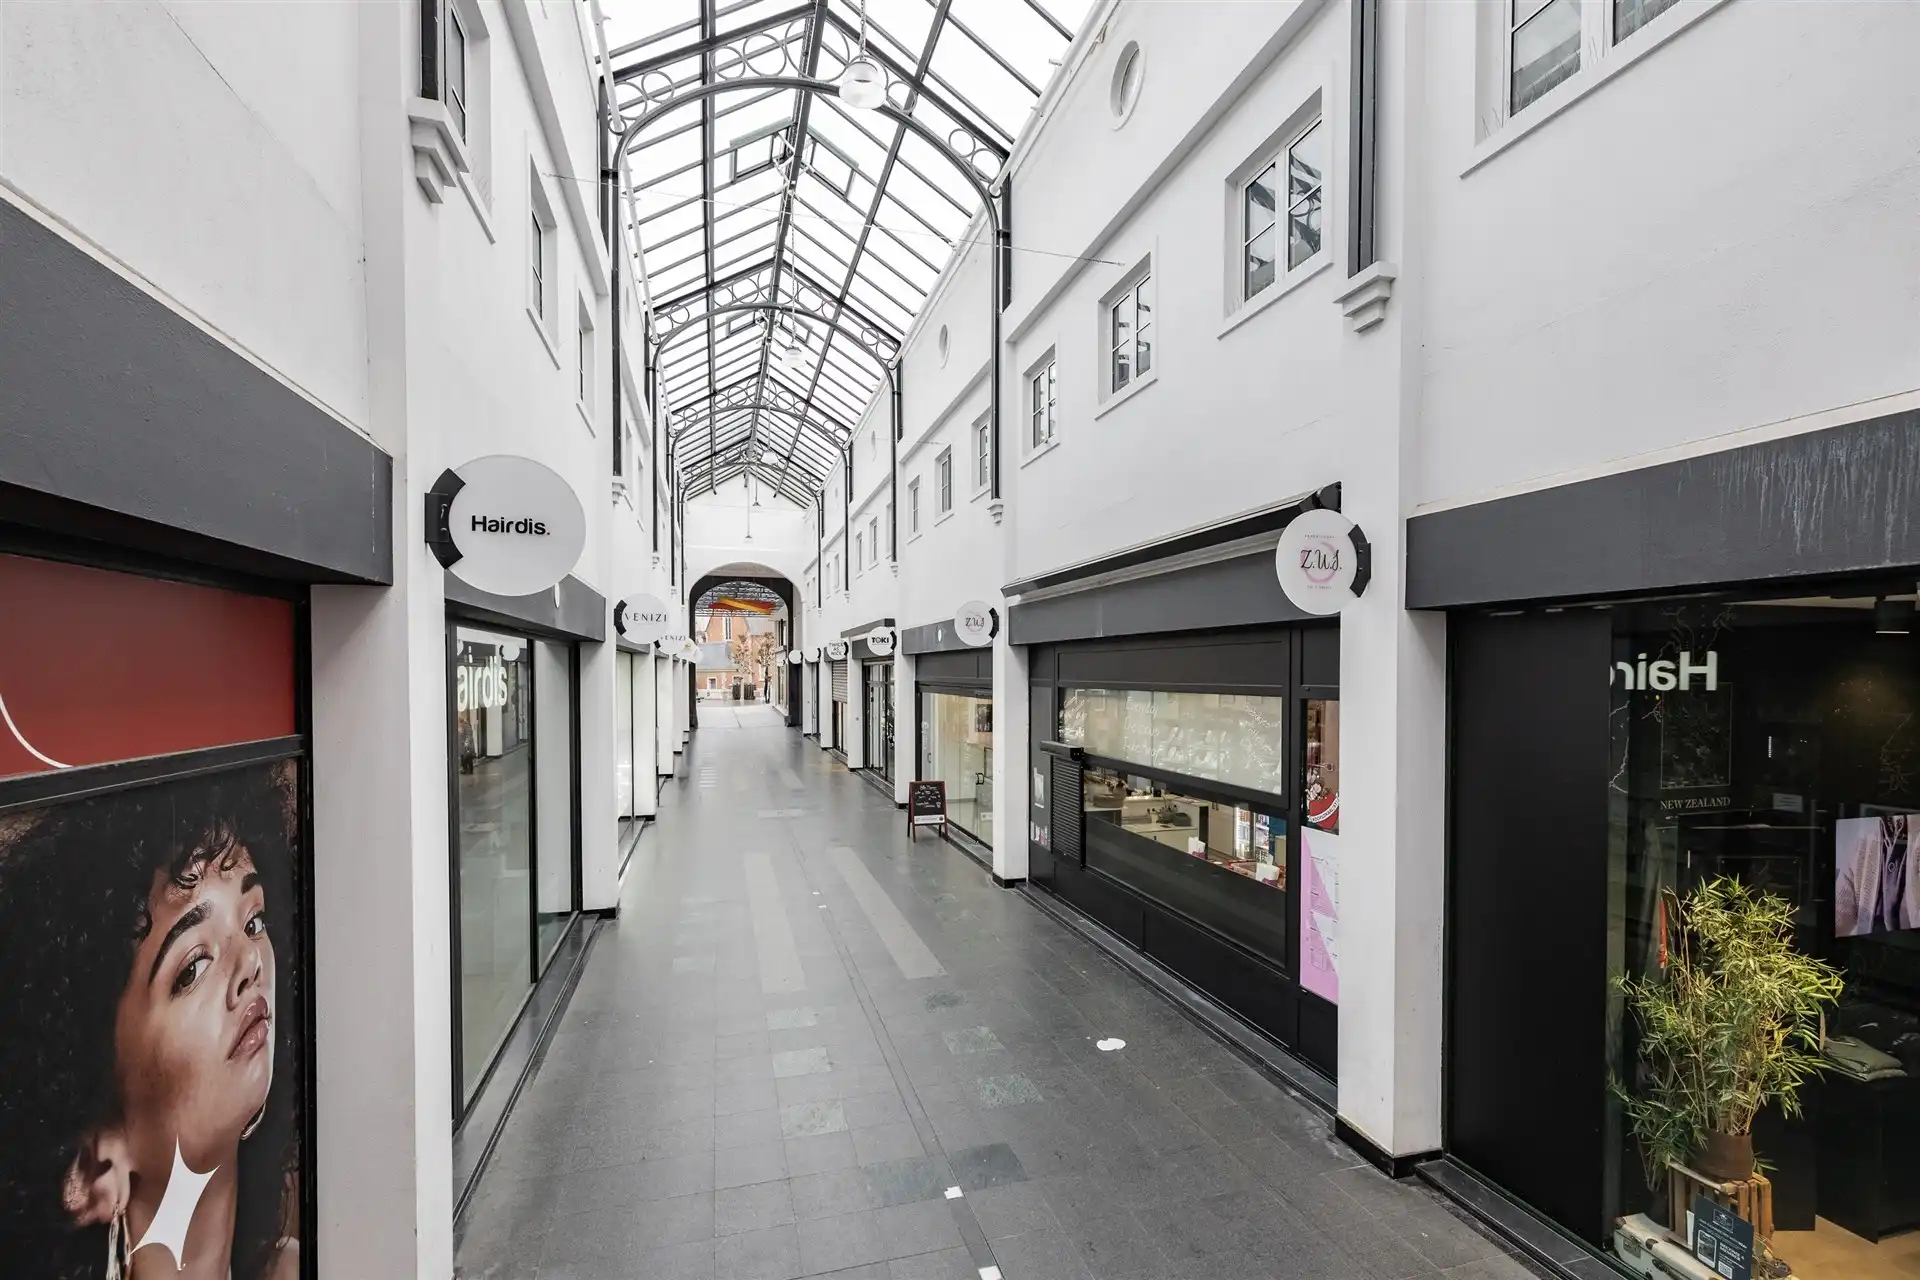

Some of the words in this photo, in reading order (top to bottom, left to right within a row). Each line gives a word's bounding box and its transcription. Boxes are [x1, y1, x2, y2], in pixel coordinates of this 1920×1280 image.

[471, 515, 550, 535] Hairdis.
[1660, 799, 1684, 810] NEW
[1685, 796, 1731, 809] ZEALAND
